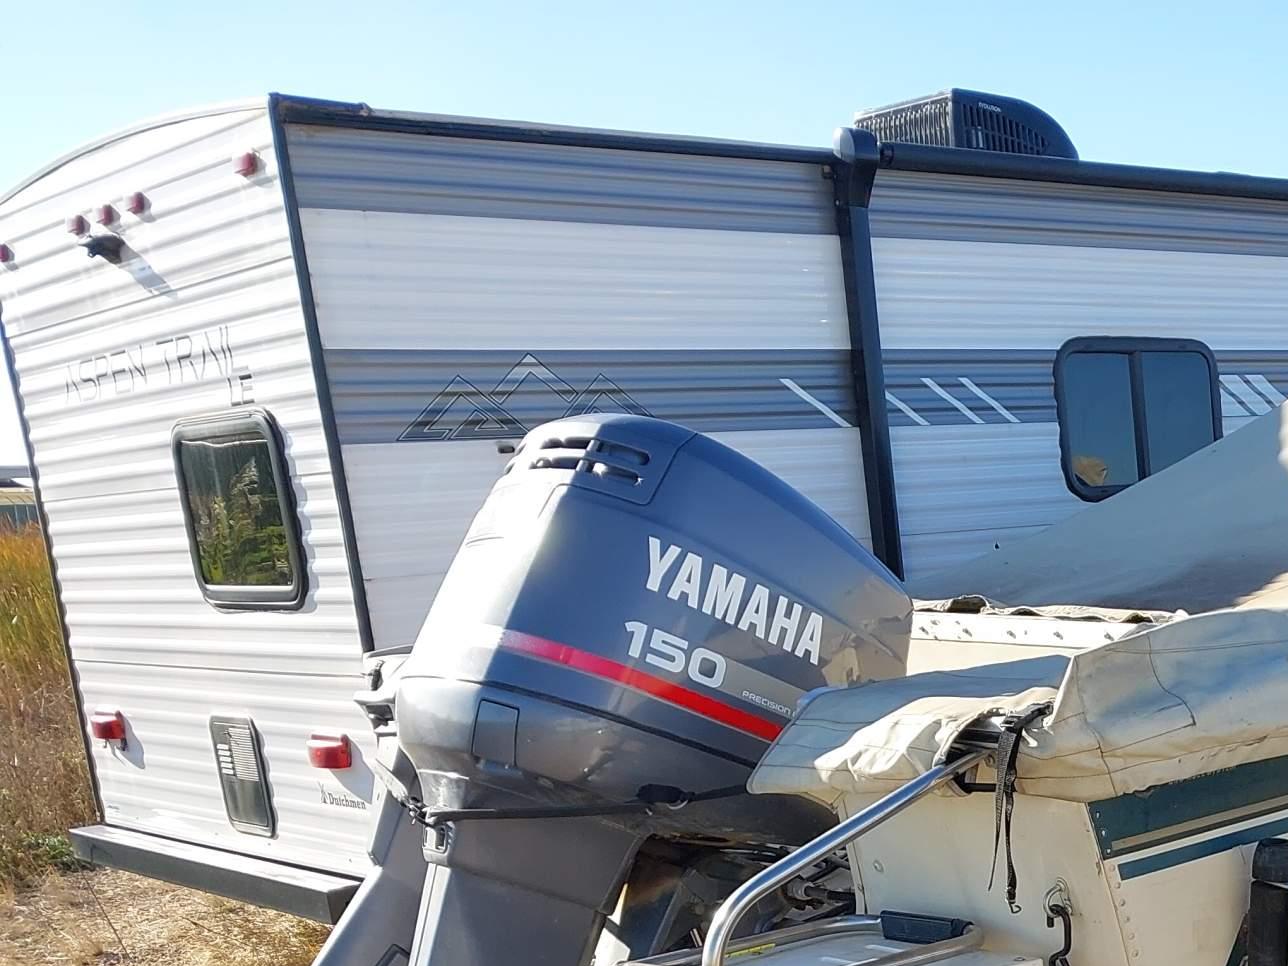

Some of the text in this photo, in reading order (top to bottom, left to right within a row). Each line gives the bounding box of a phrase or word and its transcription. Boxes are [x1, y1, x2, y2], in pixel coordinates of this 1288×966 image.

[65, 324, 249, 405] ASPEN TRAIL
[226, 372, 256, 407] LE
[646, 535, 824, 667] YAMAHA
[623, 620, 727, 689] 150
[741, 689, 792, 716] PRECISION
[327, 791, 367, 810] Dutchmen
